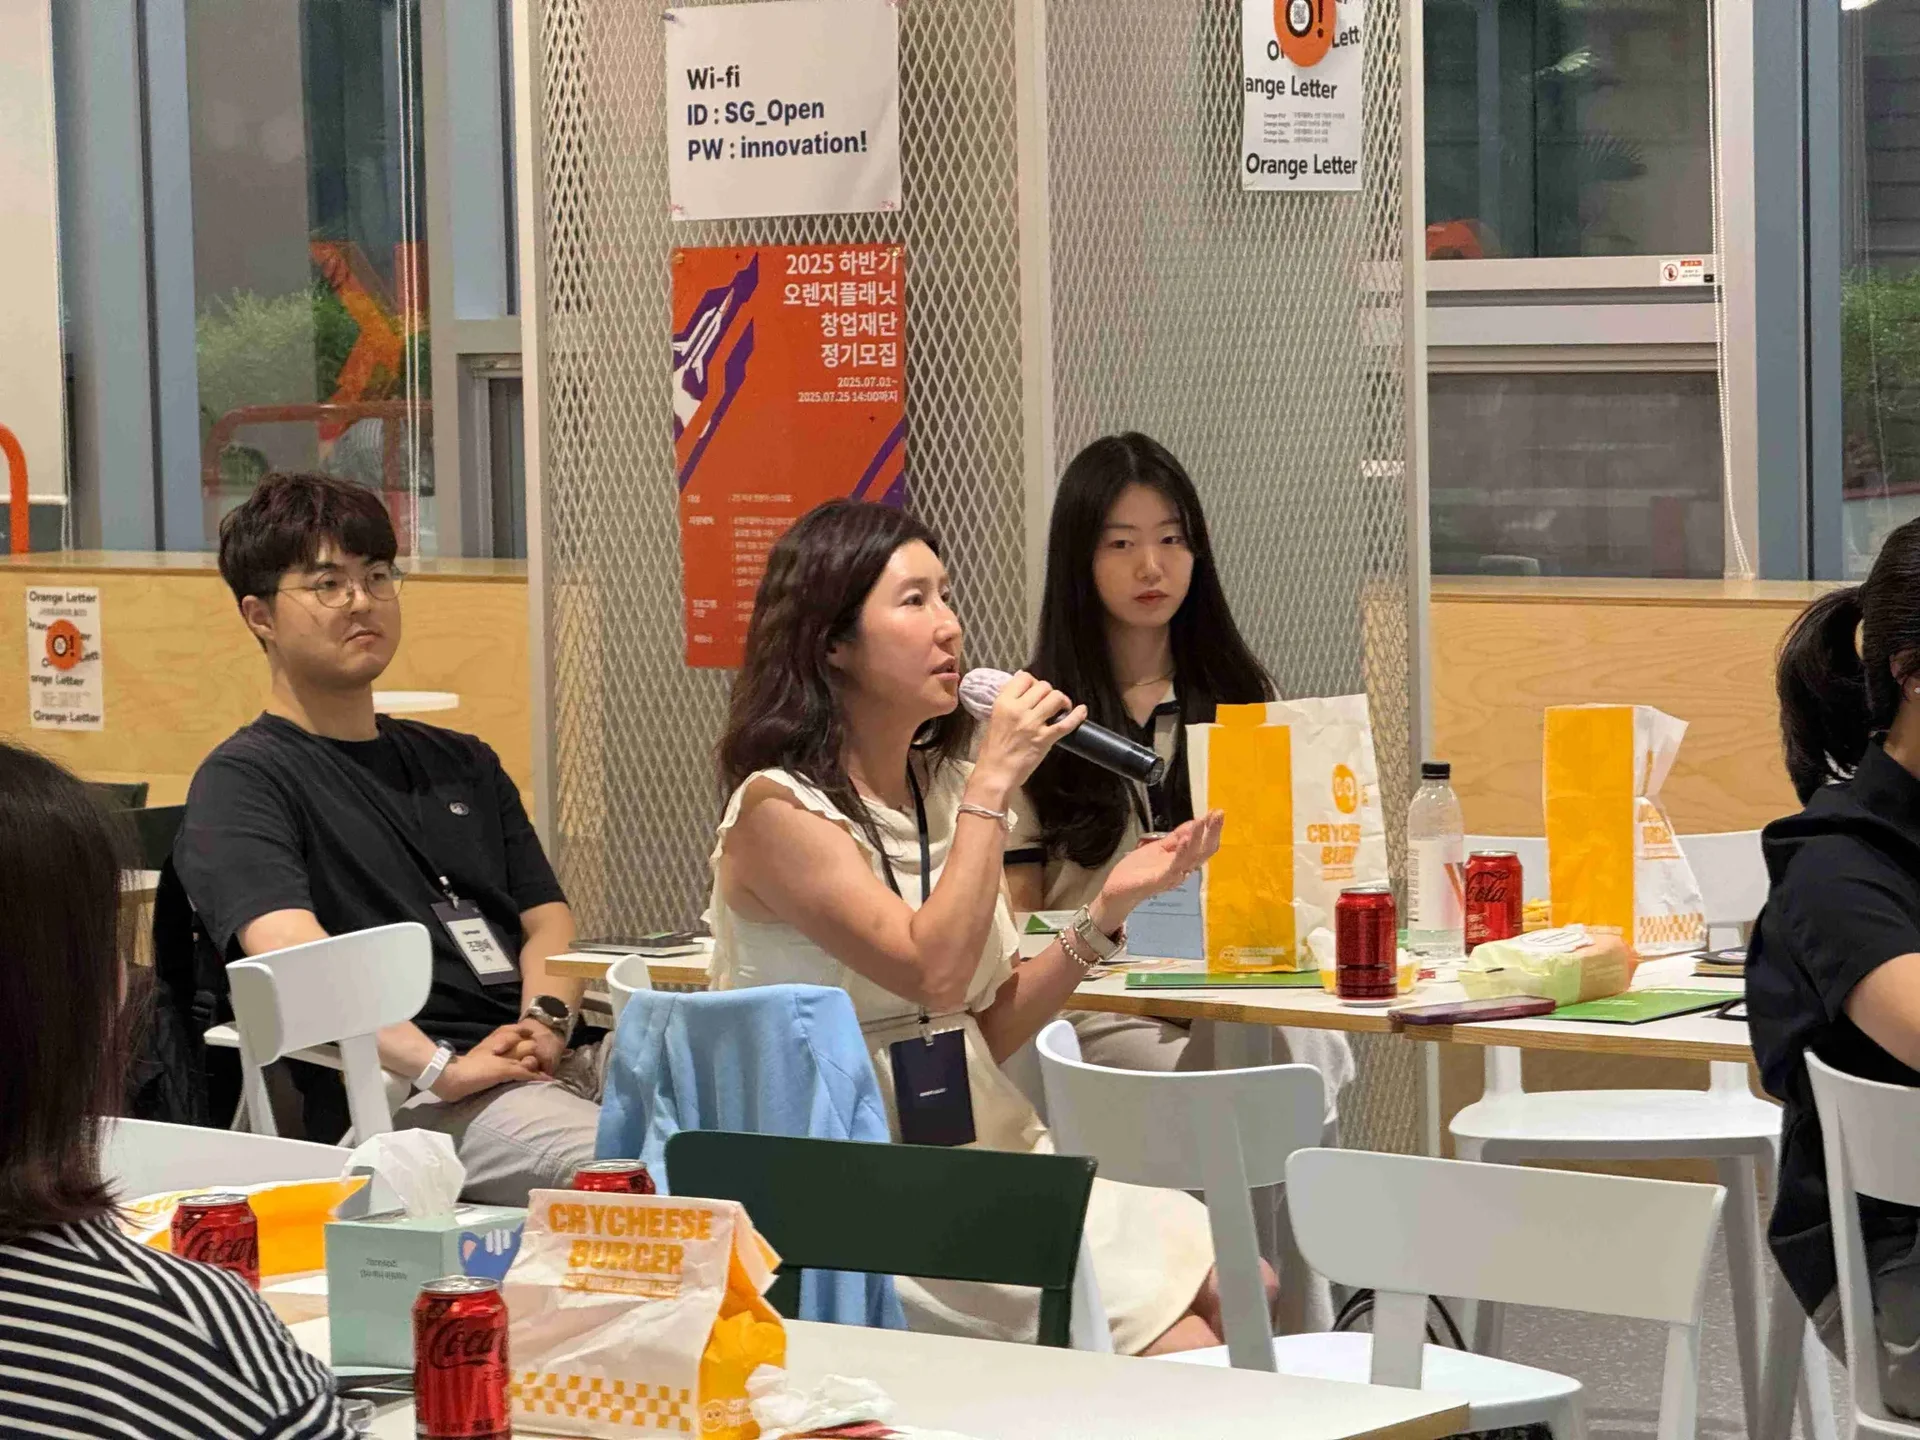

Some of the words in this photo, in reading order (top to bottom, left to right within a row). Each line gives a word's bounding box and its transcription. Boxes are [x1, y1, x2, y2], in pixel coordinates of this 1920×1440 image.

[1332, 25, 1361, 48] Lett
[686, 64, 740, 90] Wi-fi
[1245, 77, 1285, 100] ange
[1291, 75, 1338, 99] Letter
[687, 104, 708, 126] ID
[725, 99, 825, 126] SG_Open
[688, 138, 724, 161] PW
[741, 130, 868, 158] innovation!
[1246, 152, 1308, 180] Orange
[1313, 153, 1358, 175] Letter
[786, 253, 834, 275] 2025
[839, 250, 897, 276] 하반기
[783, 281, 897, 307] 오렌지플래닛
[821, 311, 898, 338] 창업재단
[821, 342, 897, 368] 정기모집
[798, 391, 850, 403] 2025.07.25
[29, 590, 63, 605] Orange
[66, 592, 97, 604] Letter
[33, 710, 67, 724] Orange
[548, 1203, 713, 1240] CRYCHEESE
[568, 1239, 684, 1275] BURGER
